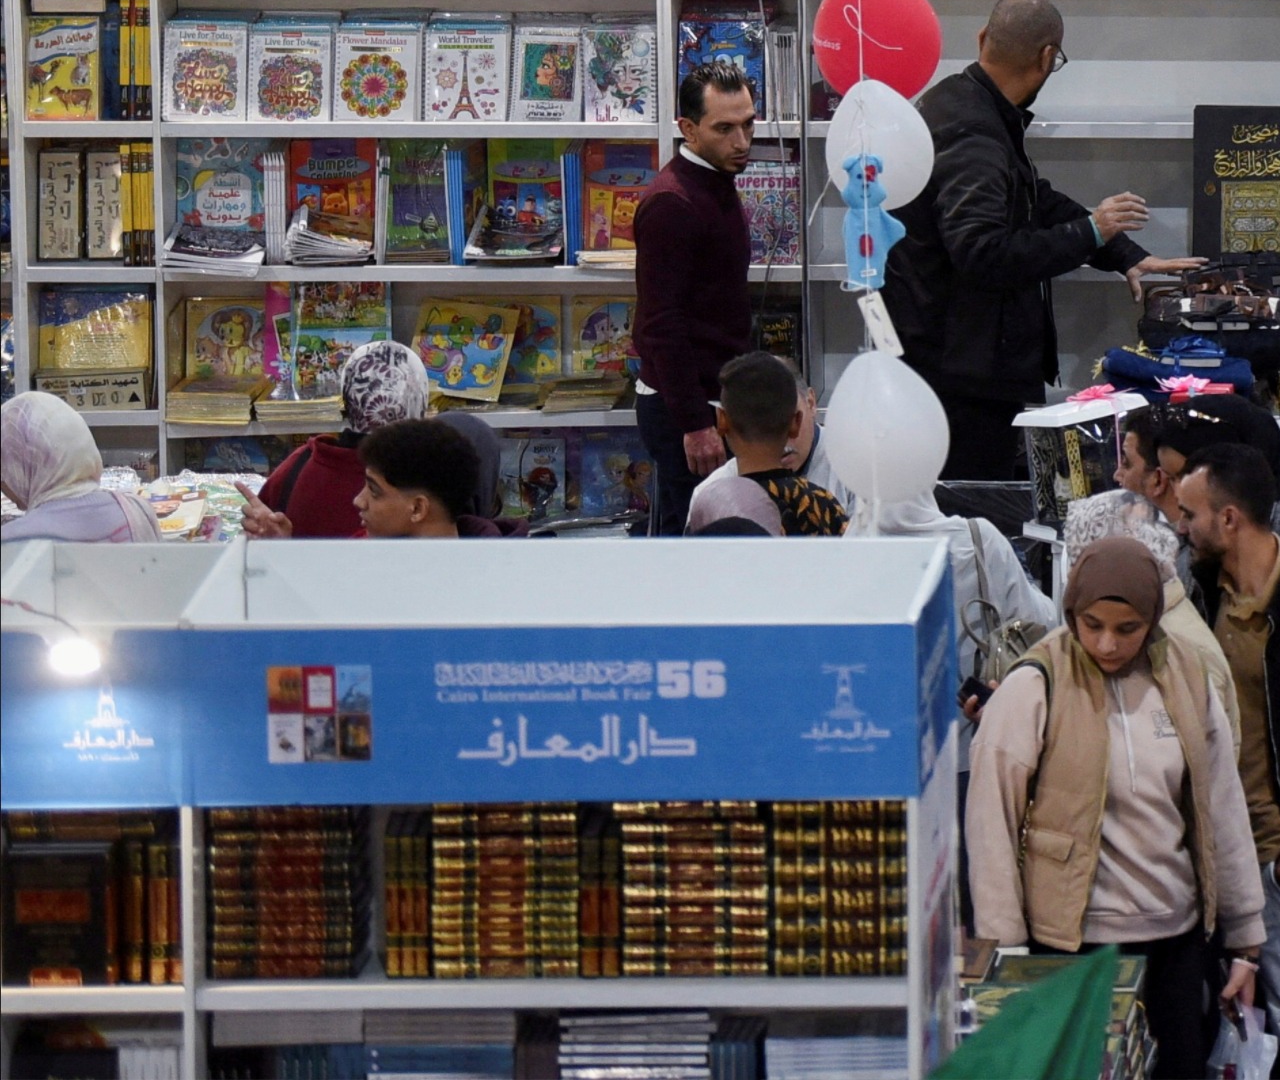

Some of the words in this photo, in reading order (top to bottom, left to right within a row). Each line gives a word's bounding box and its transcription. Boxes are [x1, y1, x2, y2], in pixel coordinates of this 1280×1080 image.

[342, 35, 369, 45] Flower
[438, 34, 463, 44] World
[464, 34, 494, 44] Traveler
[657, 659, 726, 698] 56
[458, 712, 620, 766] المعارف
[620, 712, 696, 765] دار
